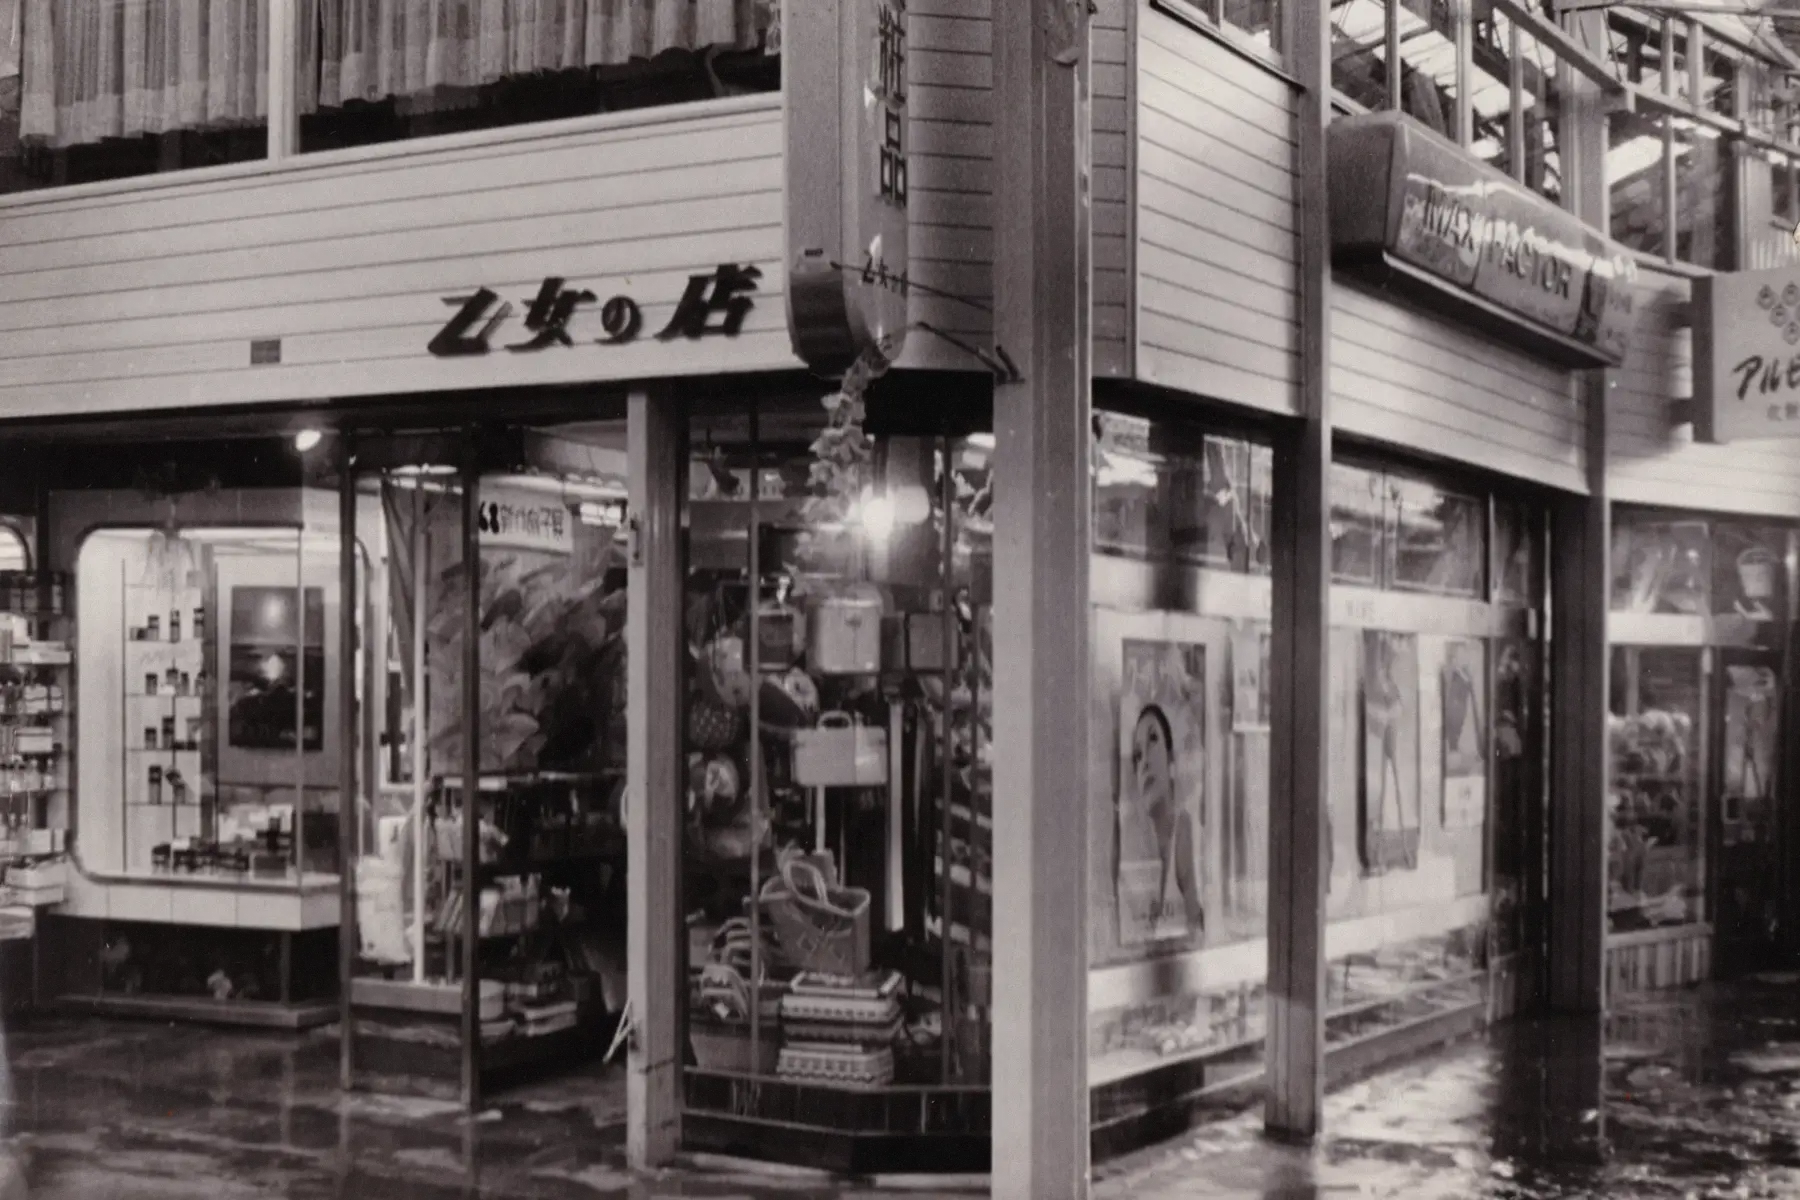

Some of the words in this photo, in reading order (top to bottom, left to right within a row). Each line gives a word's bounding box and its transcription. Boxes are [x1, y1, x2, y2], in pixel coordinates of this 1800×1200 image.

[877, 0, 907, 208] 粧品
[427, 263, 763, 357] 乙女の店
